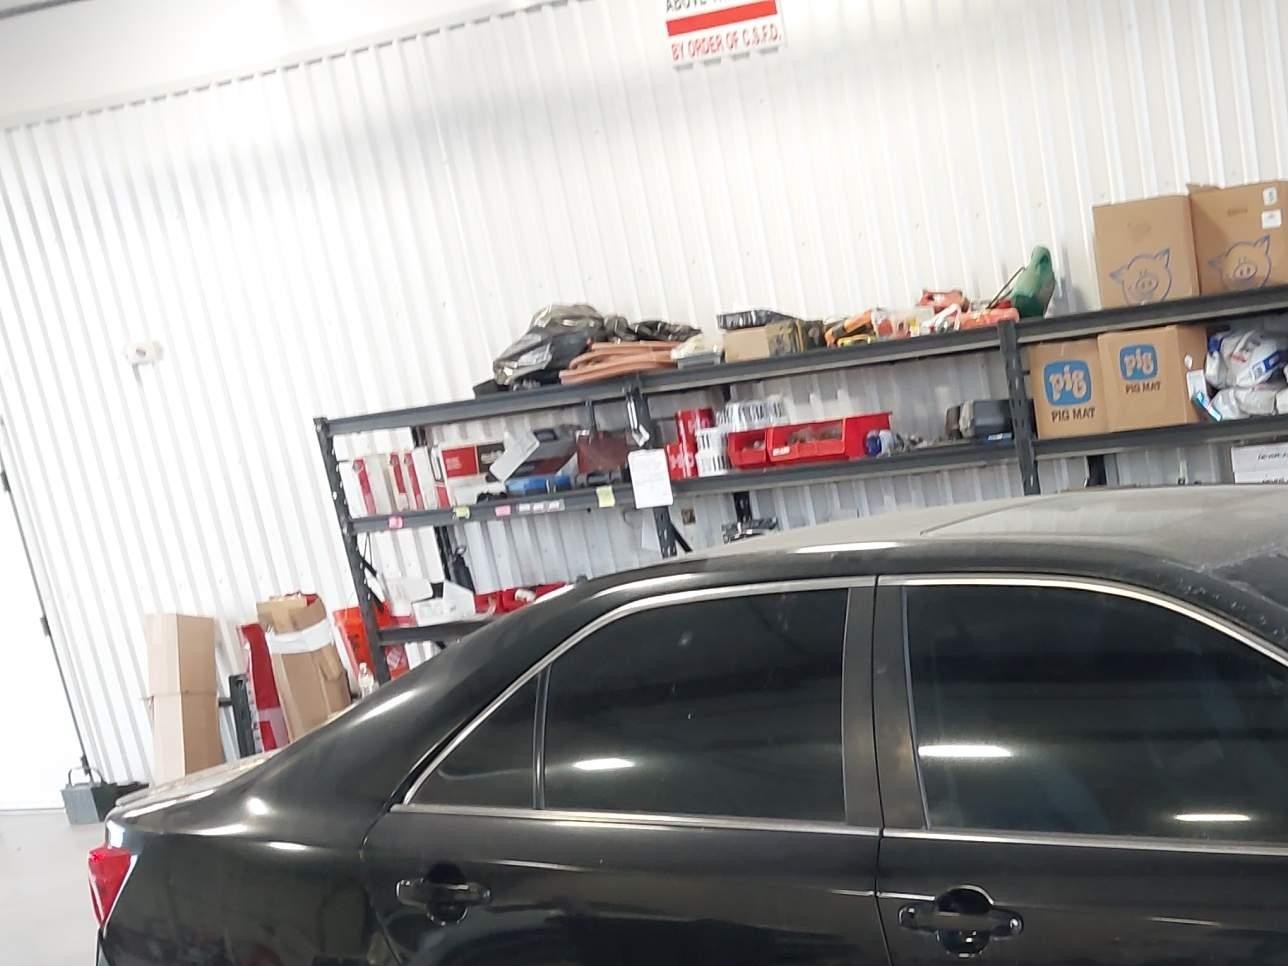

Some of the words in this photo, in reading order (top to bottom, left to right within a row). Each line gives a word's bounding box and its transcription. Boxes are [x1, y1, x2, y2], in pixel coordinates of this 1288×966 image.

[671, 41, 684, 60] BY
[687, 35, 725, 57] ORDER
[726, 30, 739, 49] OF
[1122, 347, 1154, 377] pig
[1049, 364, 1087, 400] pig
[1125, 384, 1141, 394] PIG
[1142, 381, 1161, 392] MAT
[1051, 411, 1070, 422] PIG
[1072, 407, 1096, 420] MAT
